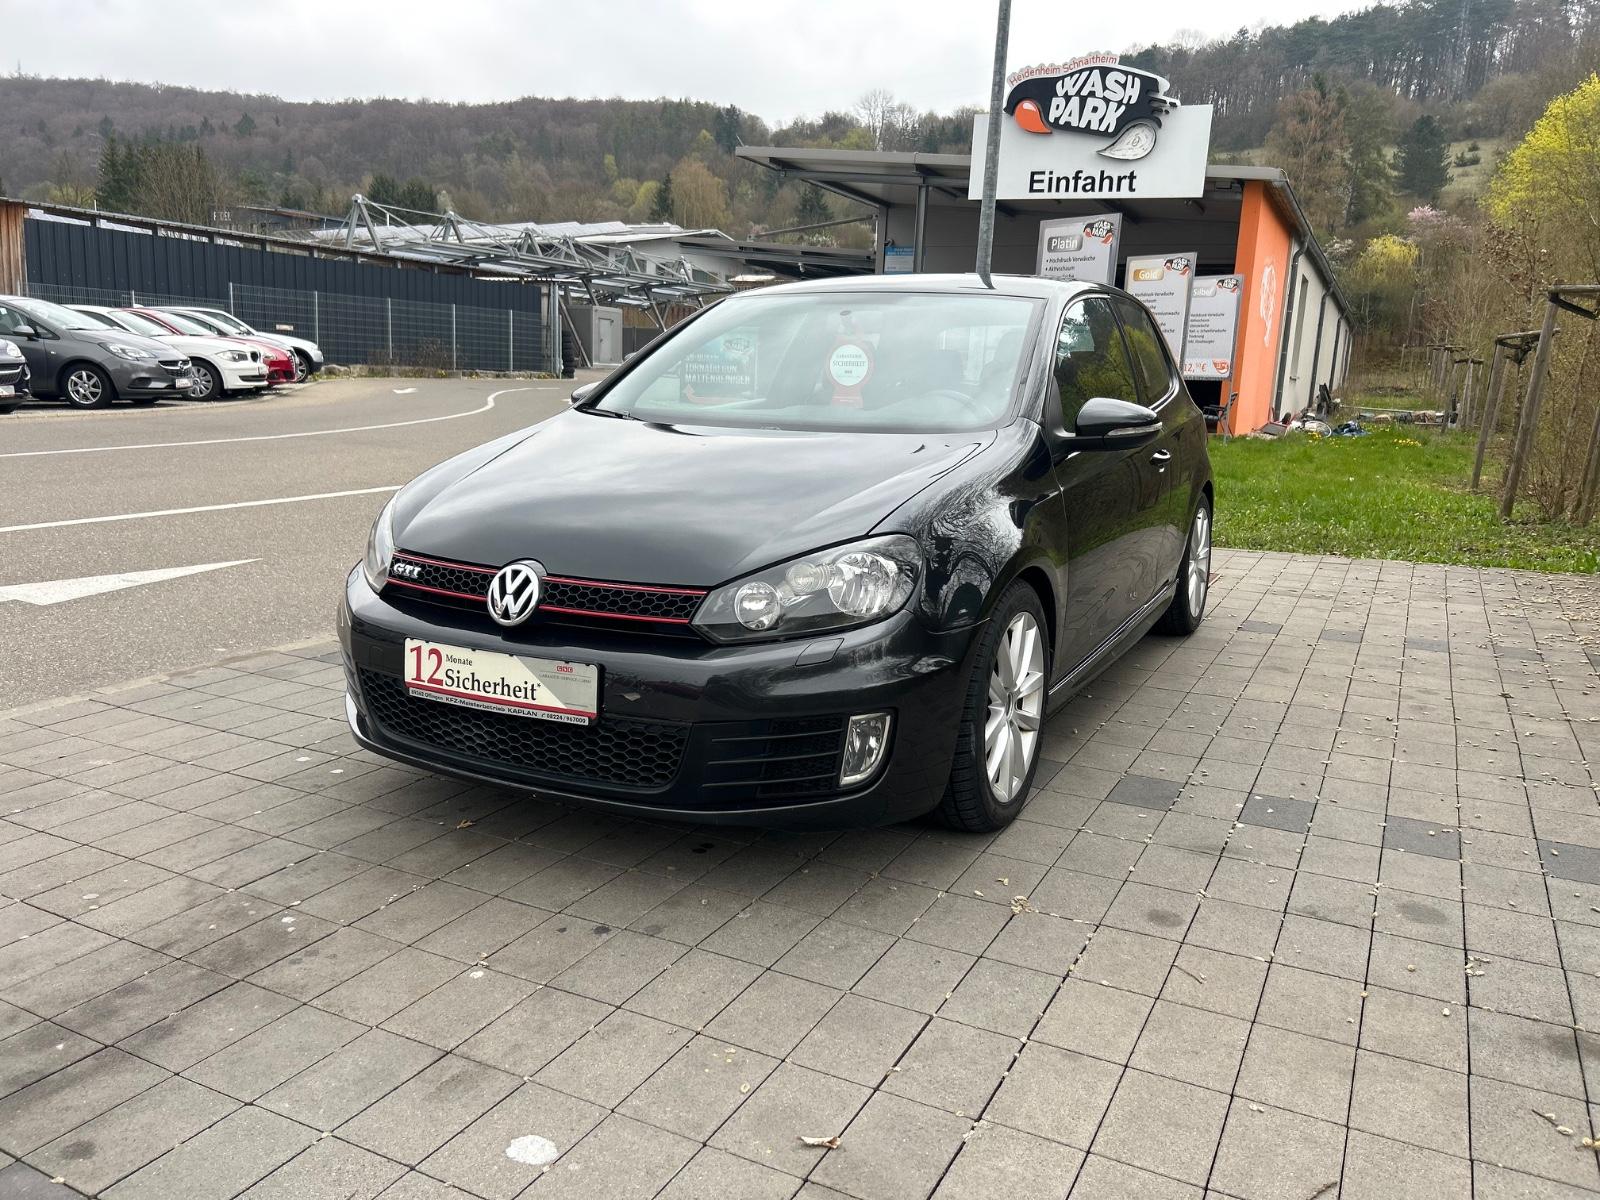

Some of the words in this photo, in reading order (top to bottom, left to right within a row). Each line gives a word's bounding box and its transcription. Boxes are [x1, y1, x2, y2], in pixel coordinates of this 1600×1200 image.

[1009, 65, 1061, 85] Heidenheim
[1062, 54, 1117, 73] Schnaitheim
[1055, 69, 1141, 105] WASH
[1048, 96, 1126, 133] PARK
[1028, 170, 1137, 194] Einfahrt
[1051, 237, 1078, 250] Platin
[1139, 270, 1158, 279] Gold
[393, 563, 422, 579] GTI
[410, 645, 443, 687] 12
[445, 654, 473, 666] Monate
[445, 697, 506, 713] KFZ-Meisterbetrieb
[507, 707, 538, 718] KAPLAN
